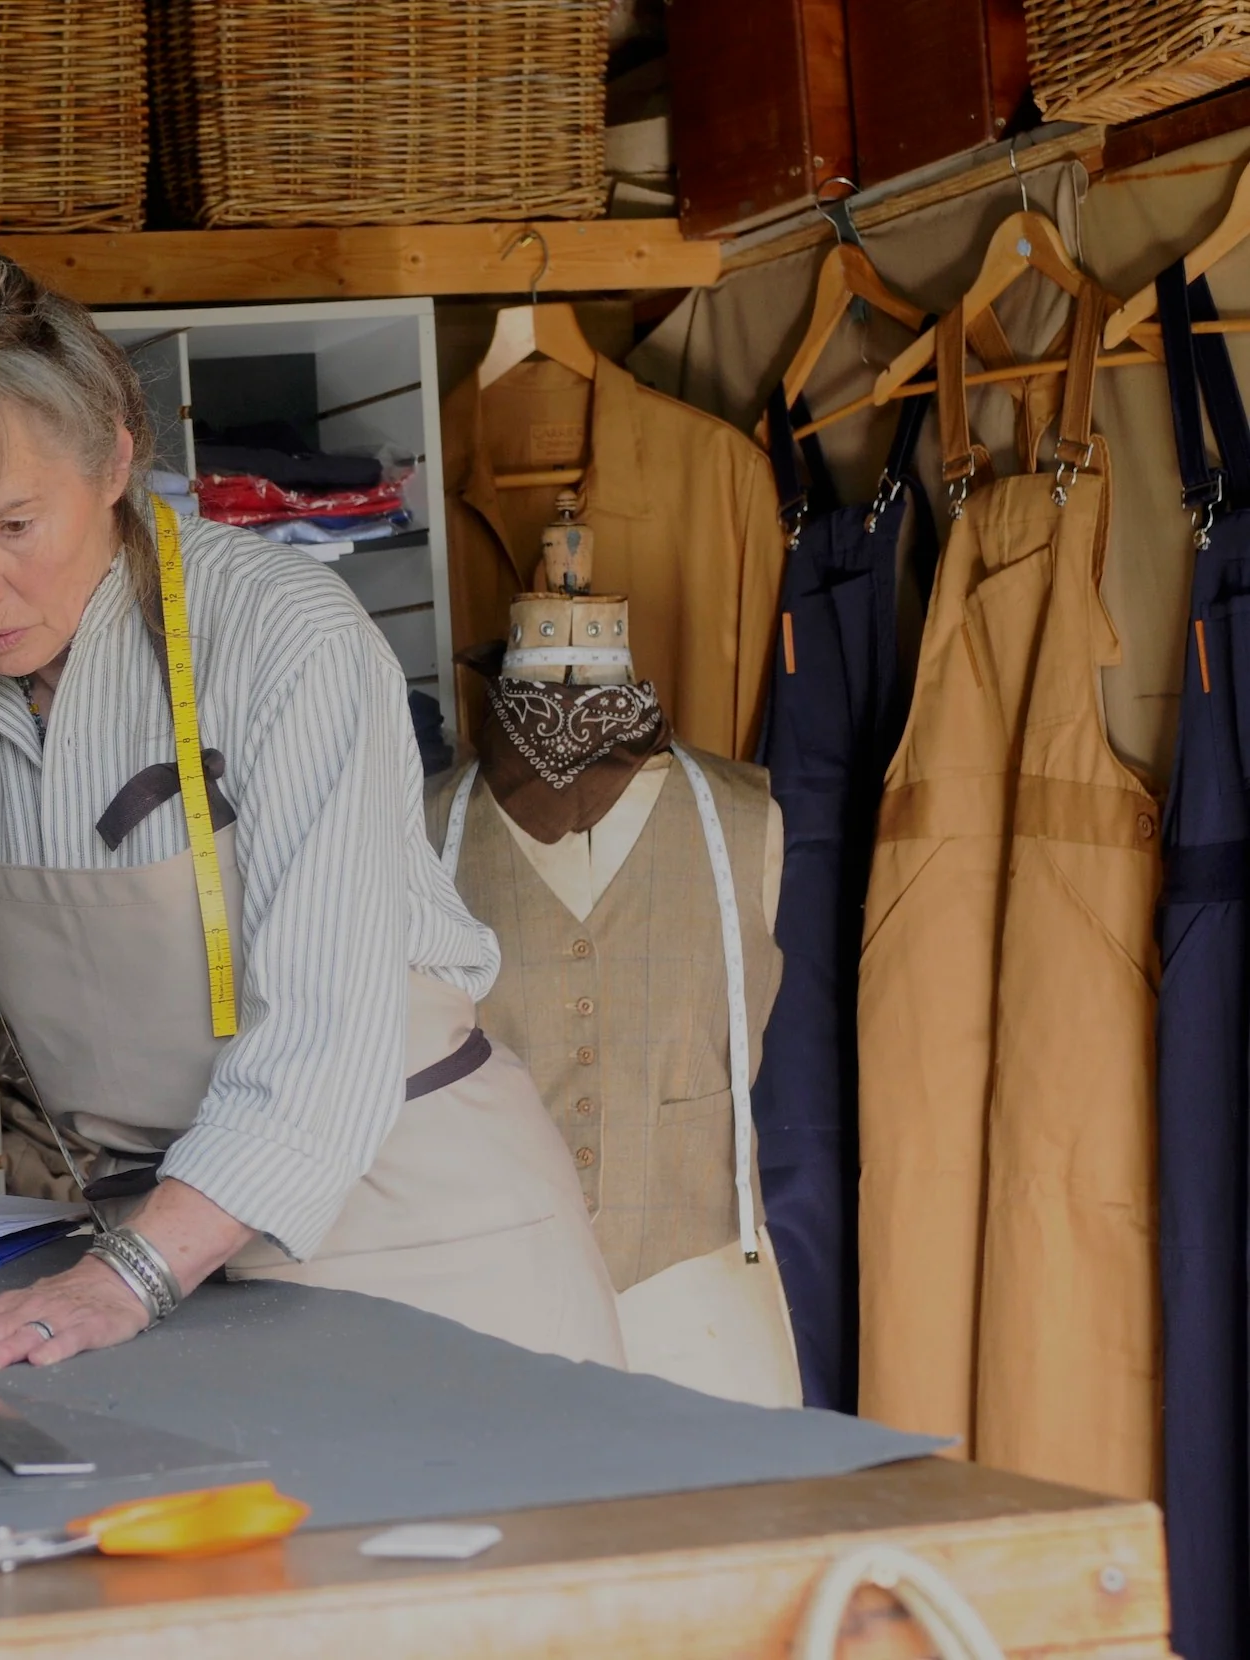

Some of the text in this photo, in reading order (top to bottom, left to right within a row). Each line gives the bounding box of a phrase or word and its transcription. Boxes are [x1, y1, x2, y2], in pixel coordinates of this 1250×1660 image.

[163, 529, 171, 539] 14
[166, 561, 175, 571] 13
[169, 593, 178, 603] 12
[172, 628, 181, 638] 11
[176, 662, 184, 674] 10
[193, 812, 201, 820] 6
[200, 851, 208, 859] 5
